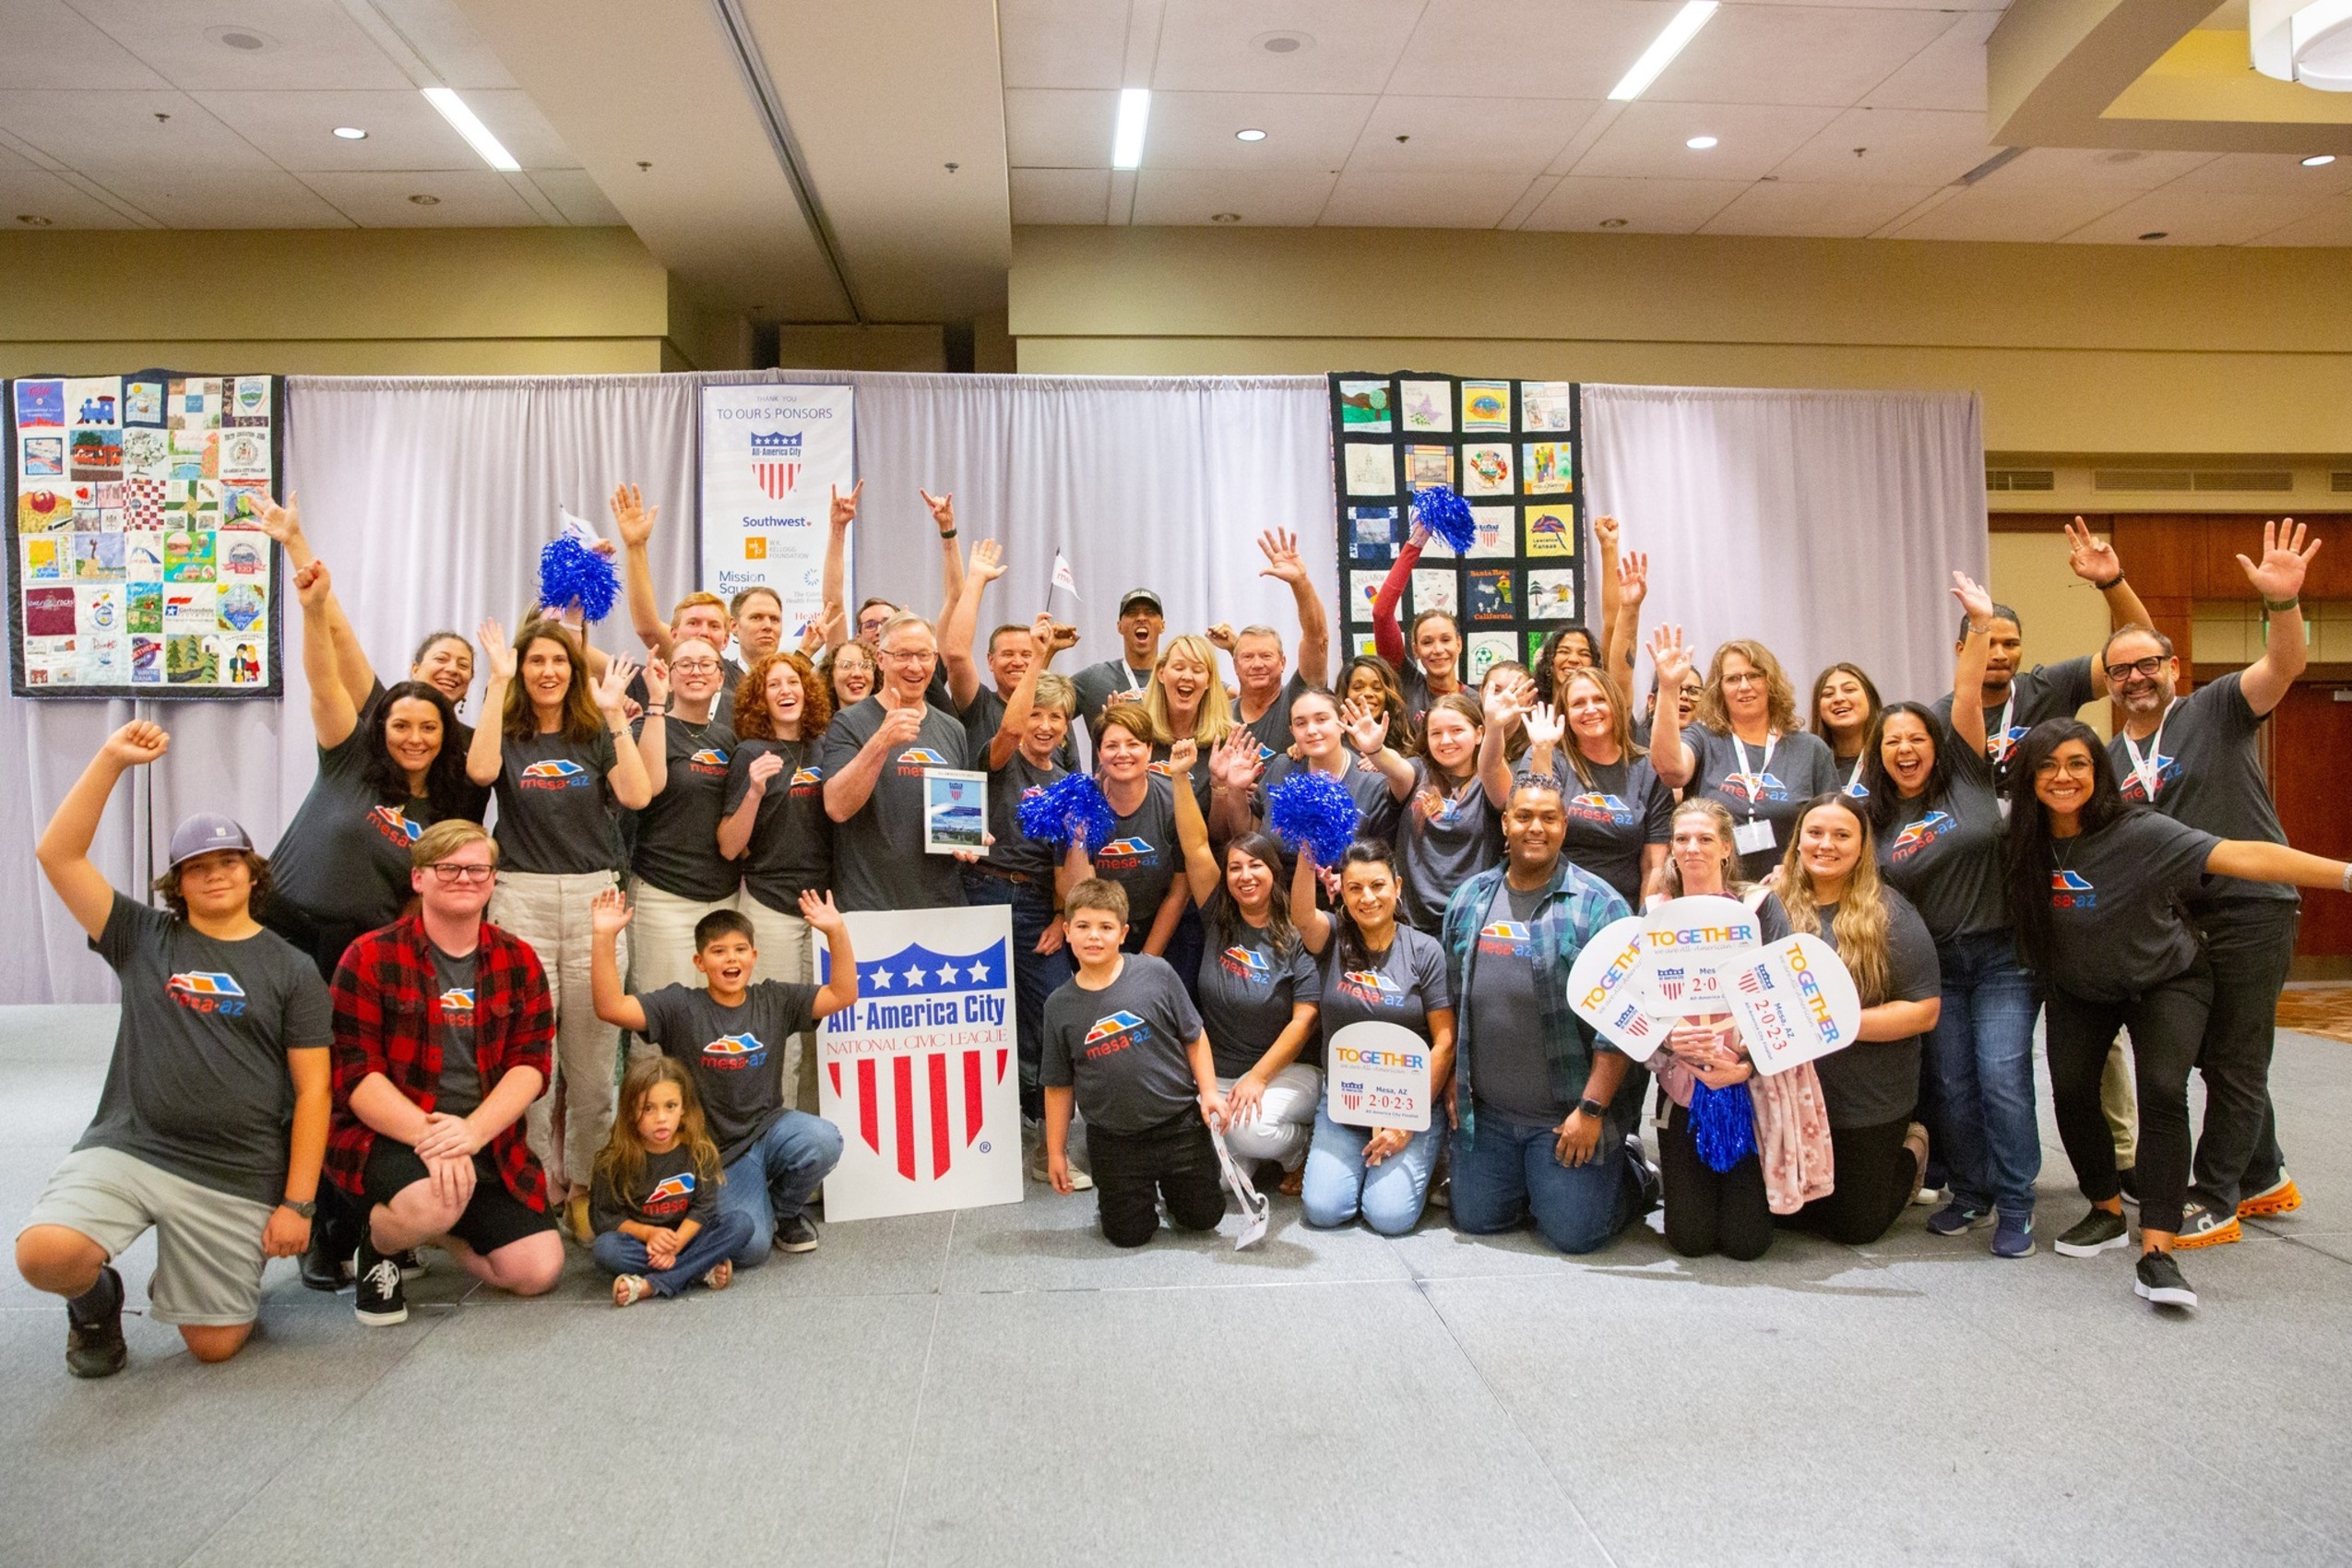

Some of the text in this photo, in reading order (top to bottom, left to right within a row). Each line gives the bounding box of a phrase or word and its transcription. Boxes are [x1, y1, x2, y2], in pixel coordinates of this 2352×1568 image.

[717, 409, 732, 420] TO
[736, 409, 761, 420] OUR
[789, 448, 802, 457] City
[742, 516, 805, 527] Southwest
[719, 571, 766, 582] Mission
[1719, 782, 1788, 802] mea·az
[1646, 925, 1752, 946] TOGETHER
[1581, 933, 1641, 1011] TOGETHE
[1786, 942, 1840, 1044] TOGETHER
[827, 993, 1005, 1033] All-America City
[826, 1028, 1008, 1055] NATIONAL CIVIC LEAGUE
[1785, 1027, 1795, 1039] AZ
[1336, 1047, 1423, 1068] TOGETHER
